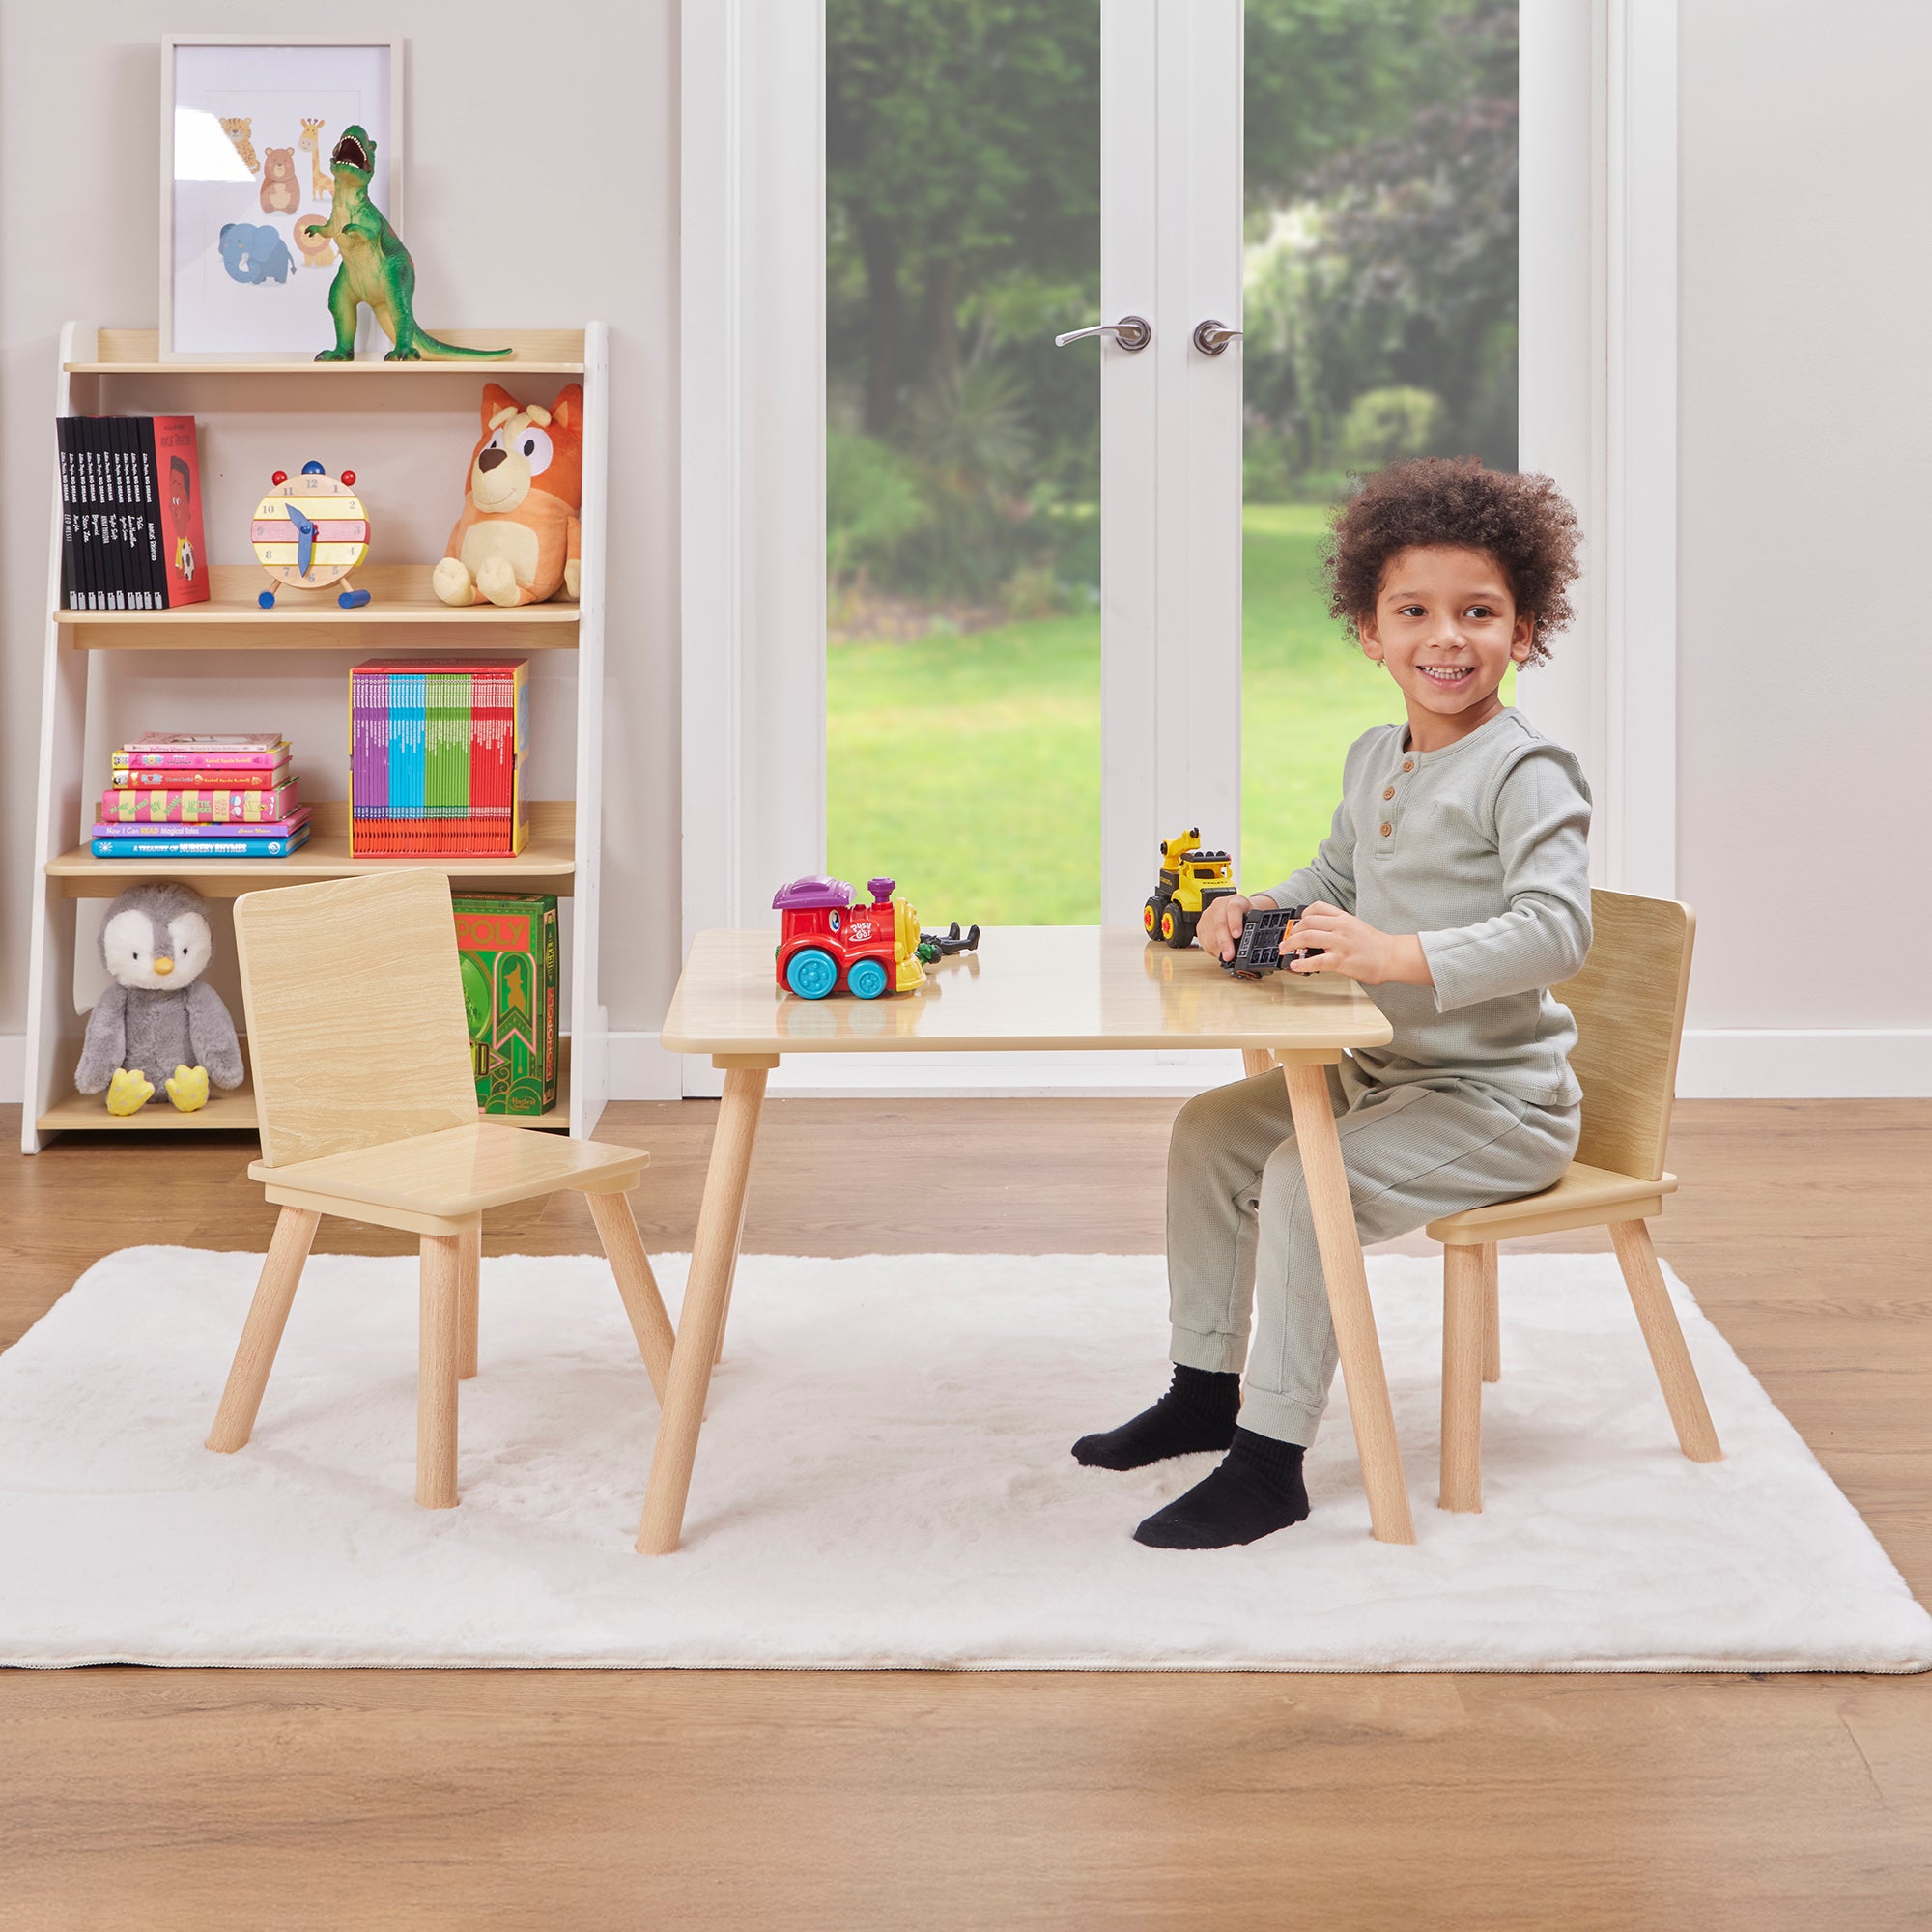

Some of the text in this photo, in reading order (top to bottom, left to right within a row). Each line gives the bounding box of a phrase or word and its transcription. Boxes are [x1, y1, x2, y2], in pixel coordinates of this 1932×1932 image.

[306, 479, 318, 488] 12
[334, 485, 339, 493] 1
[263, 506, 274, 514] 10
[354, 526, 361, 534] 3
[265, 550, 272, 559] 8
[283, 567, 290, 576] 7
[332, 566, 339, 575] 5
[308, 573, 315, 582] 6
[161, 827, 184, 835] Magical
[179, 844, 214, 853] NURSERY
[215, 844, 247, 853] RHYMES
[455, 919, 525, 945] POLY
[850, 922, 872, 933] PUSH
